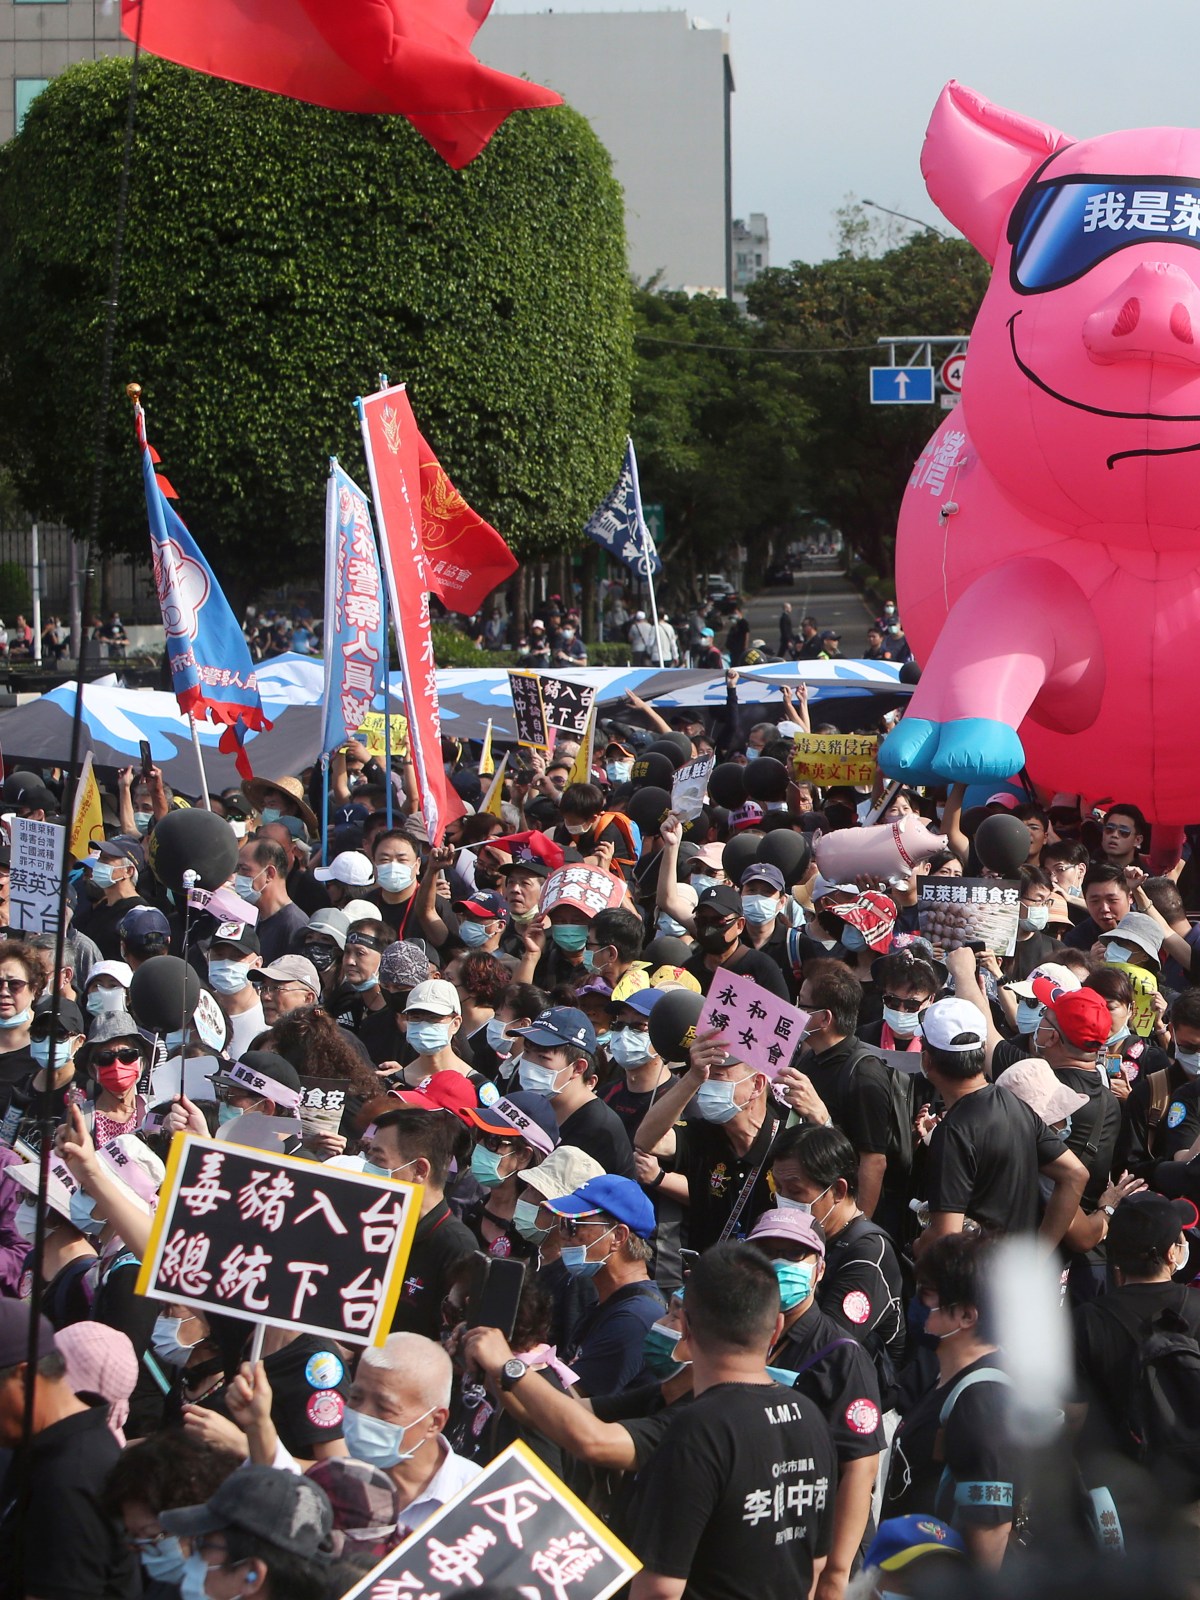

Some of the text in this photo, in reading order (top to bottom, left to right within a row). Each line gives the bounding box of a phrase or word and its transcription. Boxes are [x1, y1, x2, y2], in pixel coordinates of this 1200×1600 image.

[510, 676, 532, 741] 挺中天
[540, 680, 595, 708] 豬入台
[525, 679, 545, 744] 挺言論自由
[20, 820, 55, 836] 引進萊豬
[20, 834, 55, 849] 毒害台灣
[20, 844, 55, 860] 亡國滅種
[10, 867, 62, 898] 蔡英文
[921, 884, 1019, 906] 反萊豬 護食安
[9, 898, 59, 933] 下台
[716, 984, 794, 1041] 永和區
[706, 1008, 785, 1066] 婦女會
[299, 1086, 346, 1111] 食安
[180, 1152, 402, 1254] 毒豬入台
[159, 1229, 382, 1331] 總統下台
[967, 1485, 1013, 1504] 毒豬不
